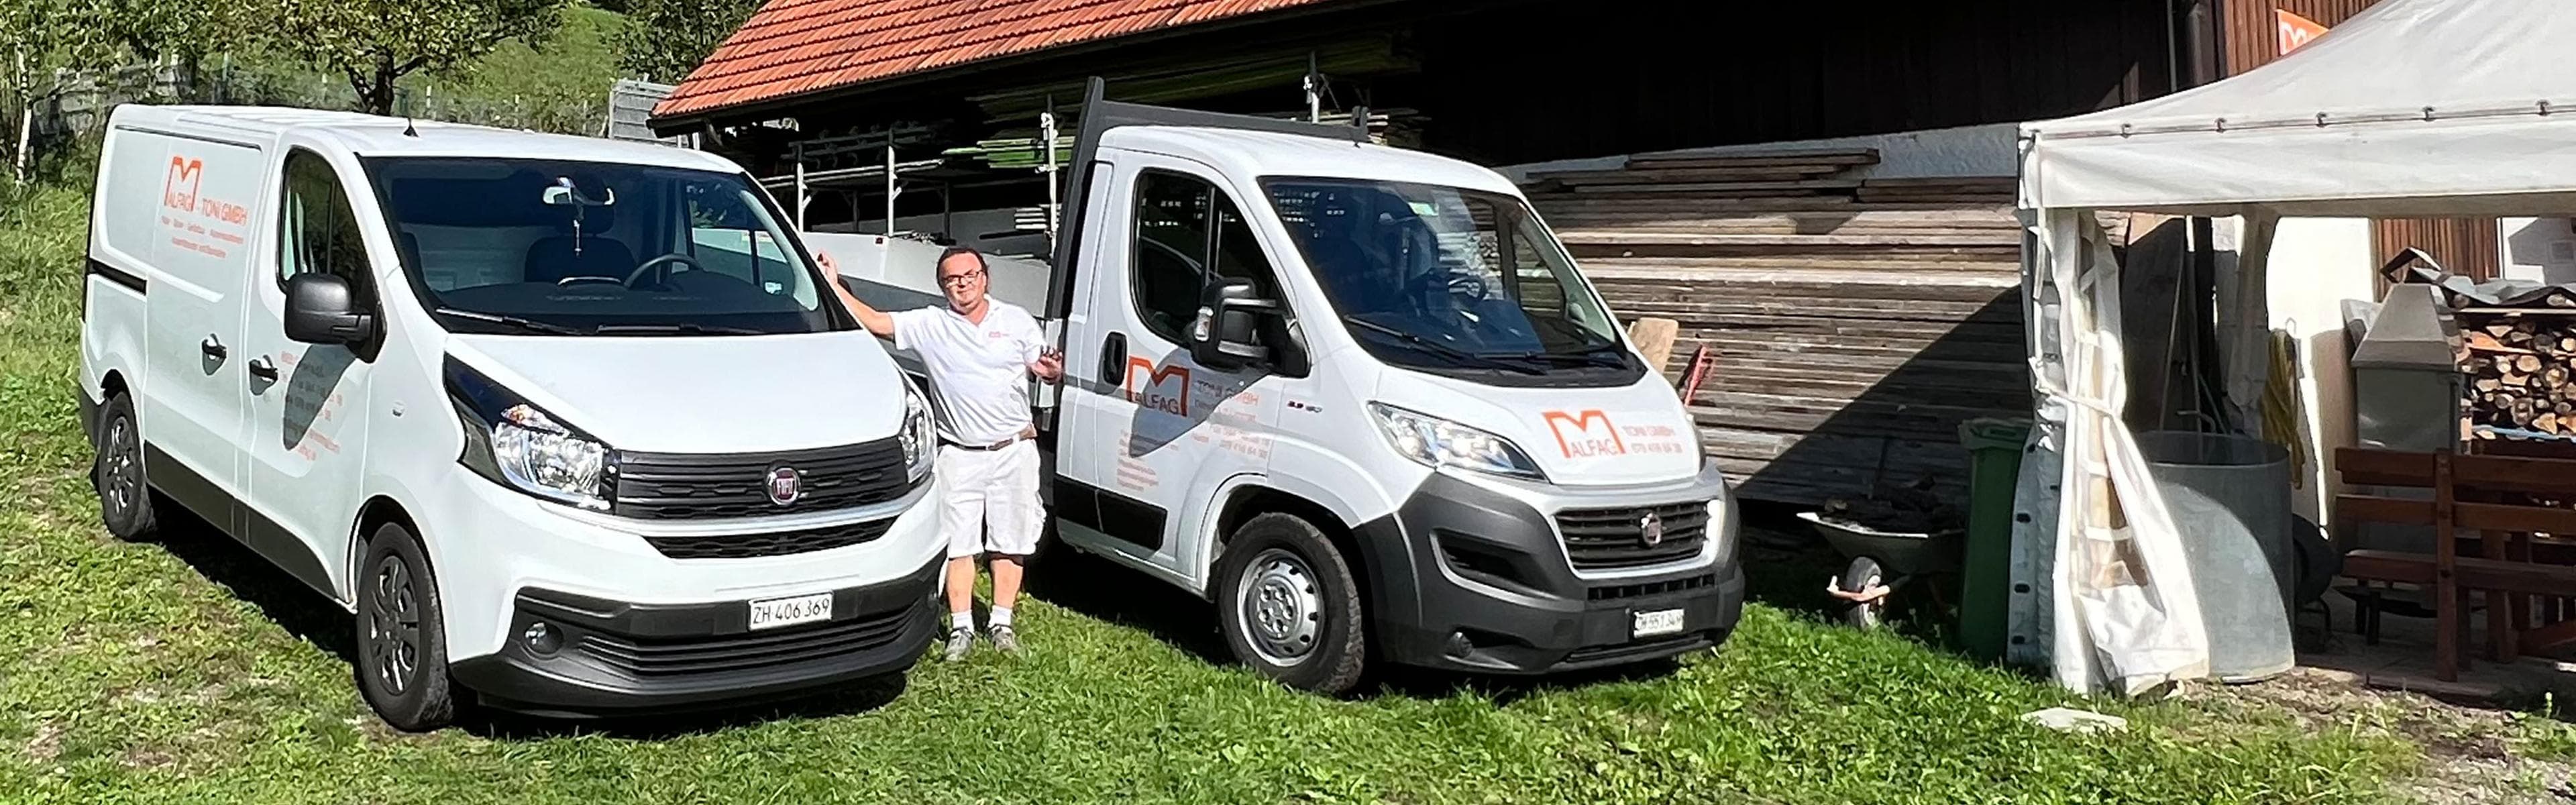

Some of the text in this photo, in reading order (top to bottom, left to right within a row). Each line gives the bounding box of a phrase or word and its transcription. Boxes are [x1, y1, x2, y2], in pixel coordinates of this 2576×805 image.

[753, 598, 830, 624] ZH 406 369
